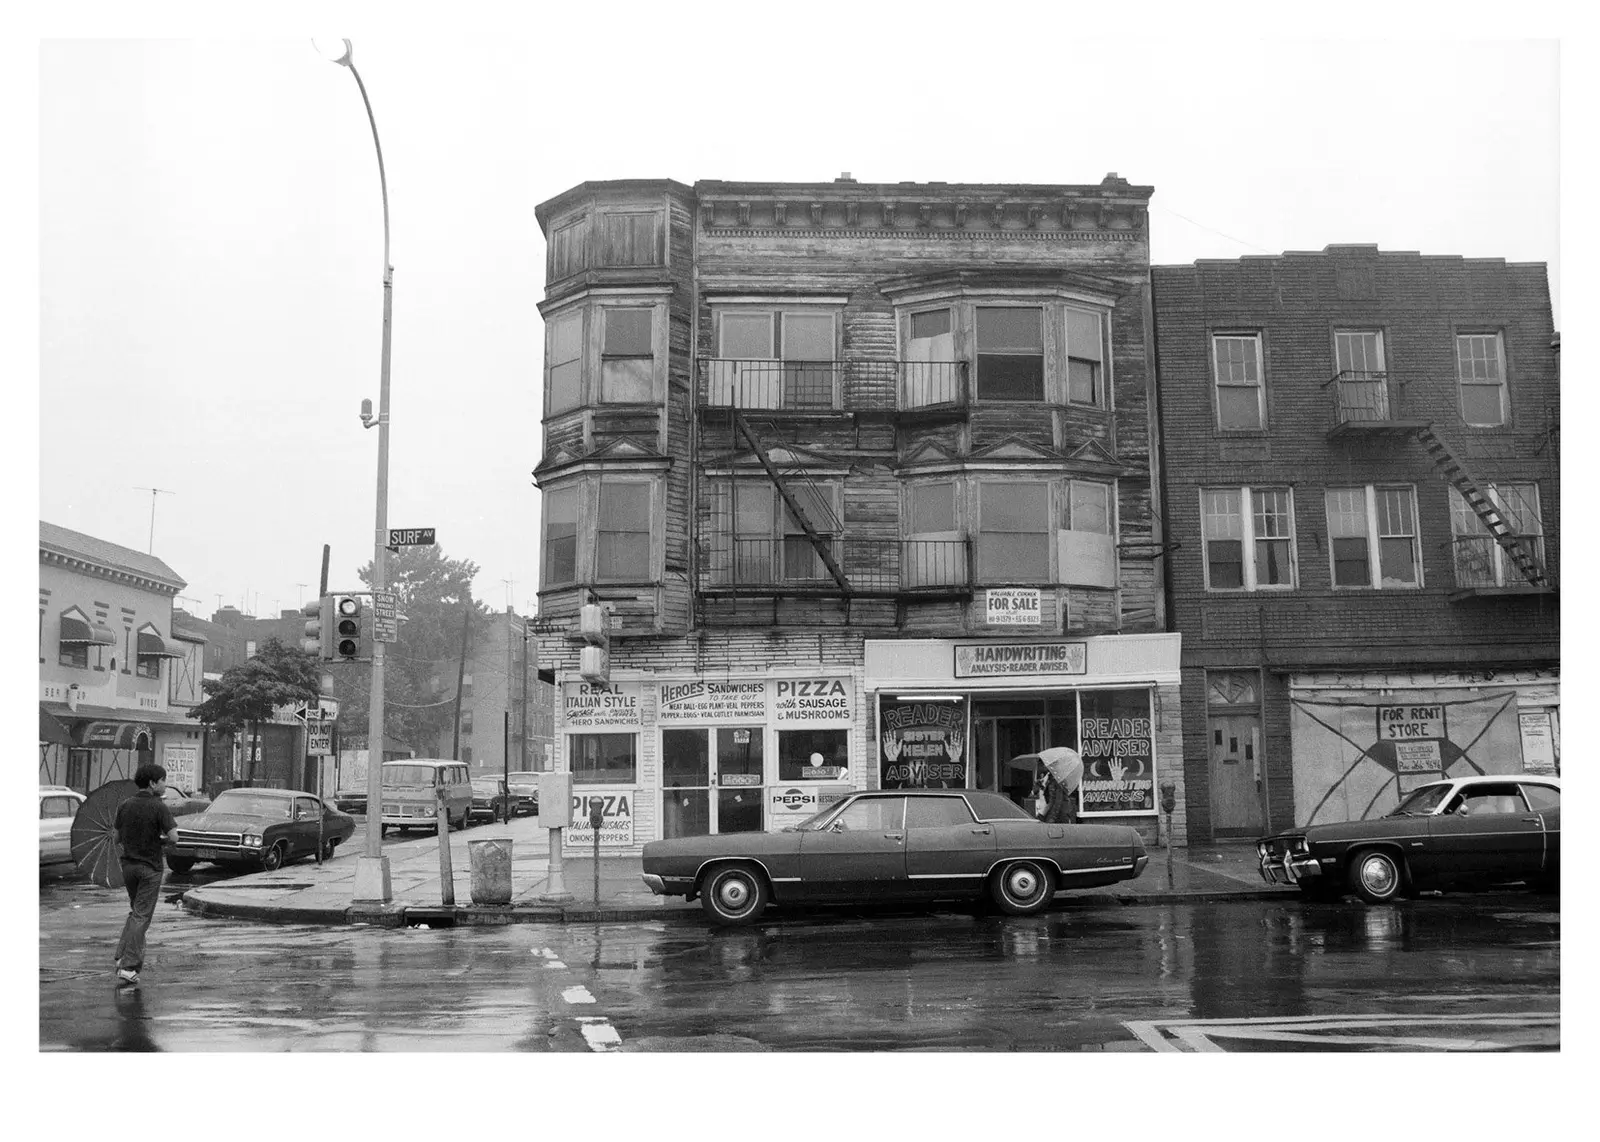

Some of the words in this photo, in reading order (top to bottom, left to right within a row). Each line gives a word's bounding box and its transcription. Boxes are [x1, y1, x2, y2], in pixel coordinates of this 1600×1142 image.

[391, 531, 421, 545] SURF
[376, 594, 394, 603] SNOW
[989, 598, 1009, 610] FOR
[1012, 598, 1038, 610] SALE
[376, 609, 394, 617] STREET
[975, 646, 1066, 662] HANDWRITING
[970, 663, 1006, 673] ANALYSIS
[1010, 662, 1037, 672] READER
[1040, 662, 1068, 671] ADVISER
[580, 684, 623, 695] REAL
[661, 682, 704, 704] HEROES
[708, 683, 764, 694] SANDWICHES
[777, 680, 846, 697] PIZZA
[566, 697, 600, 708] ITALIAN
[604, 696, 636, 708] STYLE
[776, 698, 796, 708] with
[798, 698, 847, 708] SAUSAGE
[786, 710, 850, 719] MUSHROOMS
[883, 704, 964, 730] READER
[1382, 708, 1404, 721] FOR
[1410, 707, 1440, 720] RENT
[310, 725, 318, 735] DO
[320, 725, 331, 735] NOT
[1082, 718, 1151, 738] READER
[1389, 723, 1429, 737] STORE
[311, 738, 329, 749] ENTER
[1081, 739, 1149, 757] ADVISER
[903, 744, 943, 757] HELEN
[885, 763, 965, 780] ADVISER
[1082, 780, 1152, 791] HANDWRITING
[773, 795, 816, 803] PEPSI
[1083, 791, 1145, 802] ANALYSIS
[573, 796, 630, 817] PIZA
[601, 821, 632, 830] AUSAGES
[570, 834, 594, 842] ONIONS
[599, 833, 629, 841] PEPPERS
